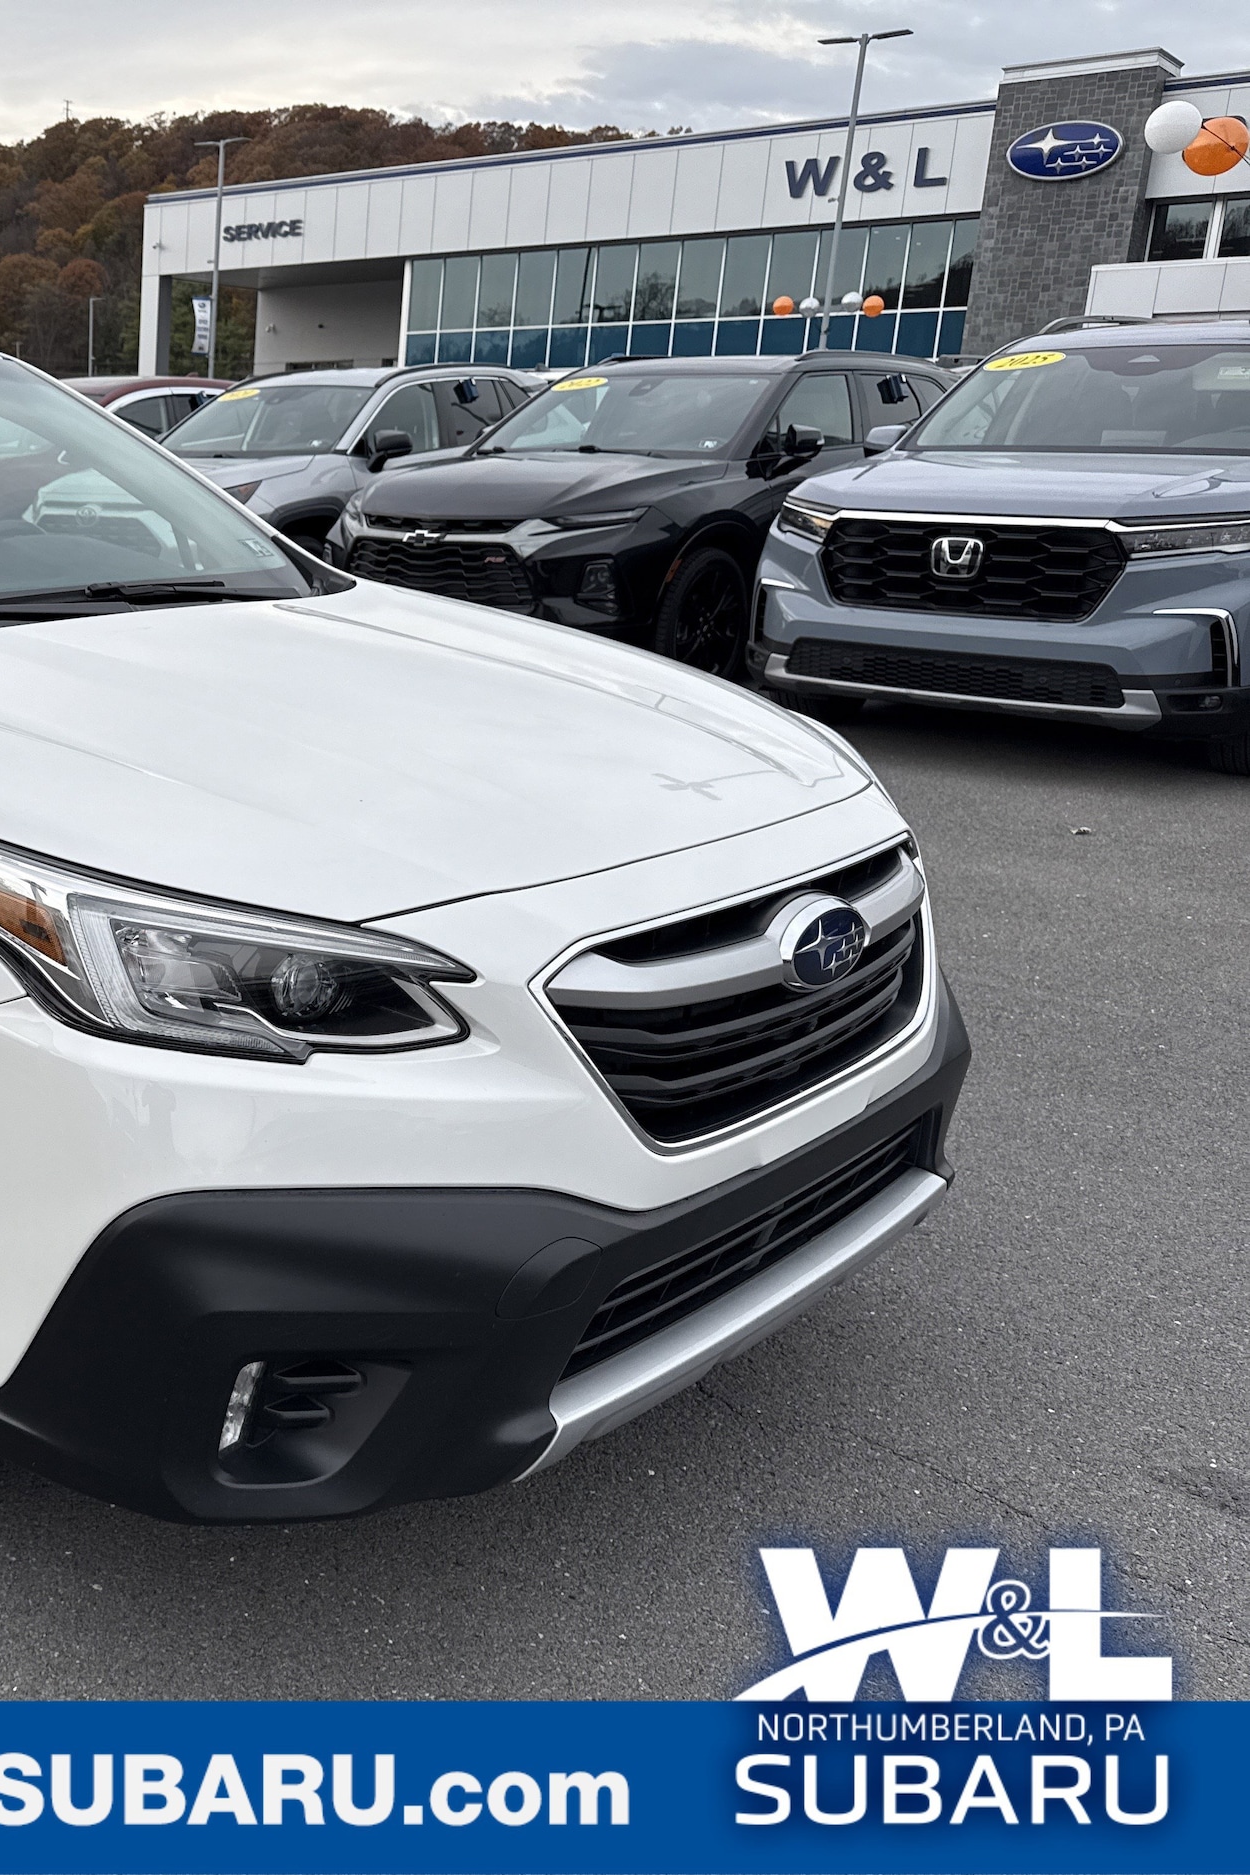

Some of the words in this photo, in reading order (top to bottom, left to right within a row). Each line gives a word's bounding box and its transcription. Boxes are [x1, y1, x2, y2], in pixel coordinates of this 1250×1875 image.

[785, 155, 841, 198] W
[853, 151, 894, 193] &
[913, 147, 948, 188] L
[222, 219, 303, 242] SERVICE
[994, 352, 1056, 368] 2025
